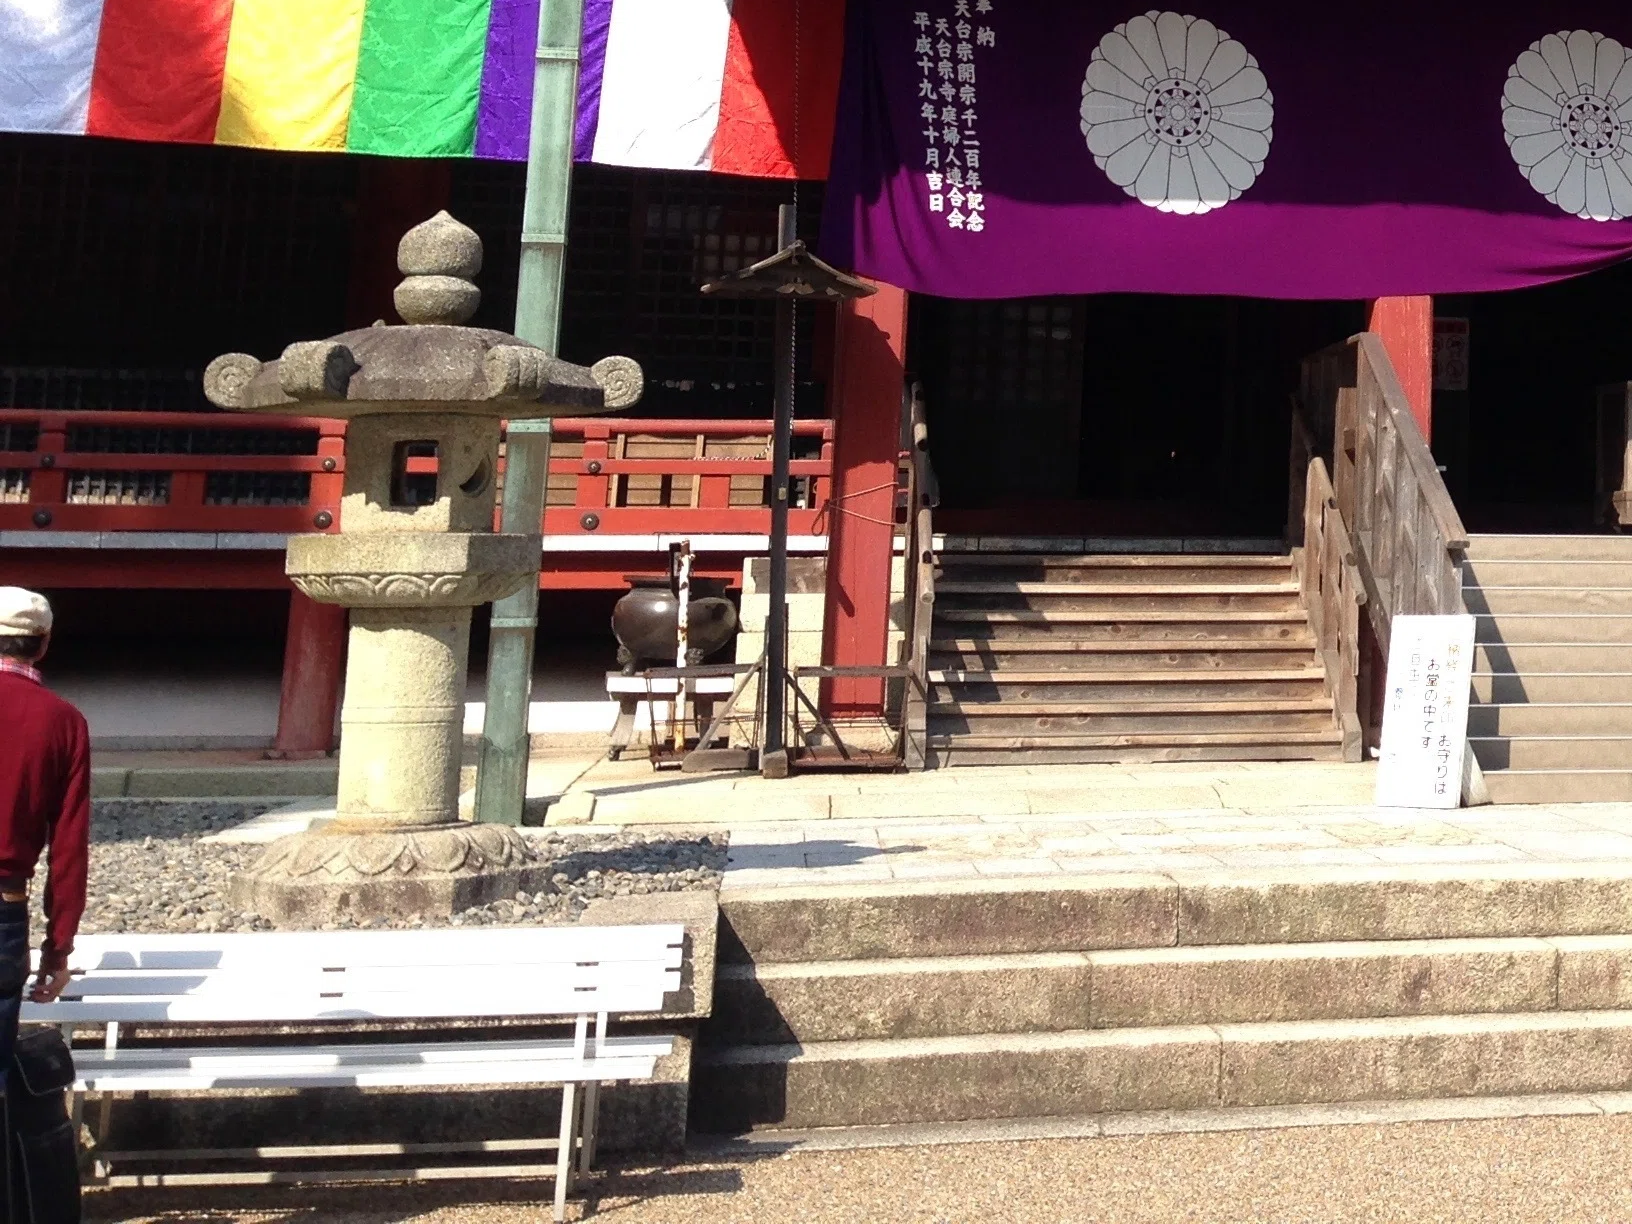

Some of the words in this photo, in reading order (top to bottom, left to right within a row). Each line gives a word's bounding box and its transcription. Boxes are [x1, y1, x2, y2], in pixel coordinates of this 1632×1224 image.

[912, 11, 945, 213] 平成十九年十月吉日
[934, 17, 967, 231] 天台宗寺庭婦人連合会
[954, 0, 985, 232] 天台宗開宗千二百年記念
